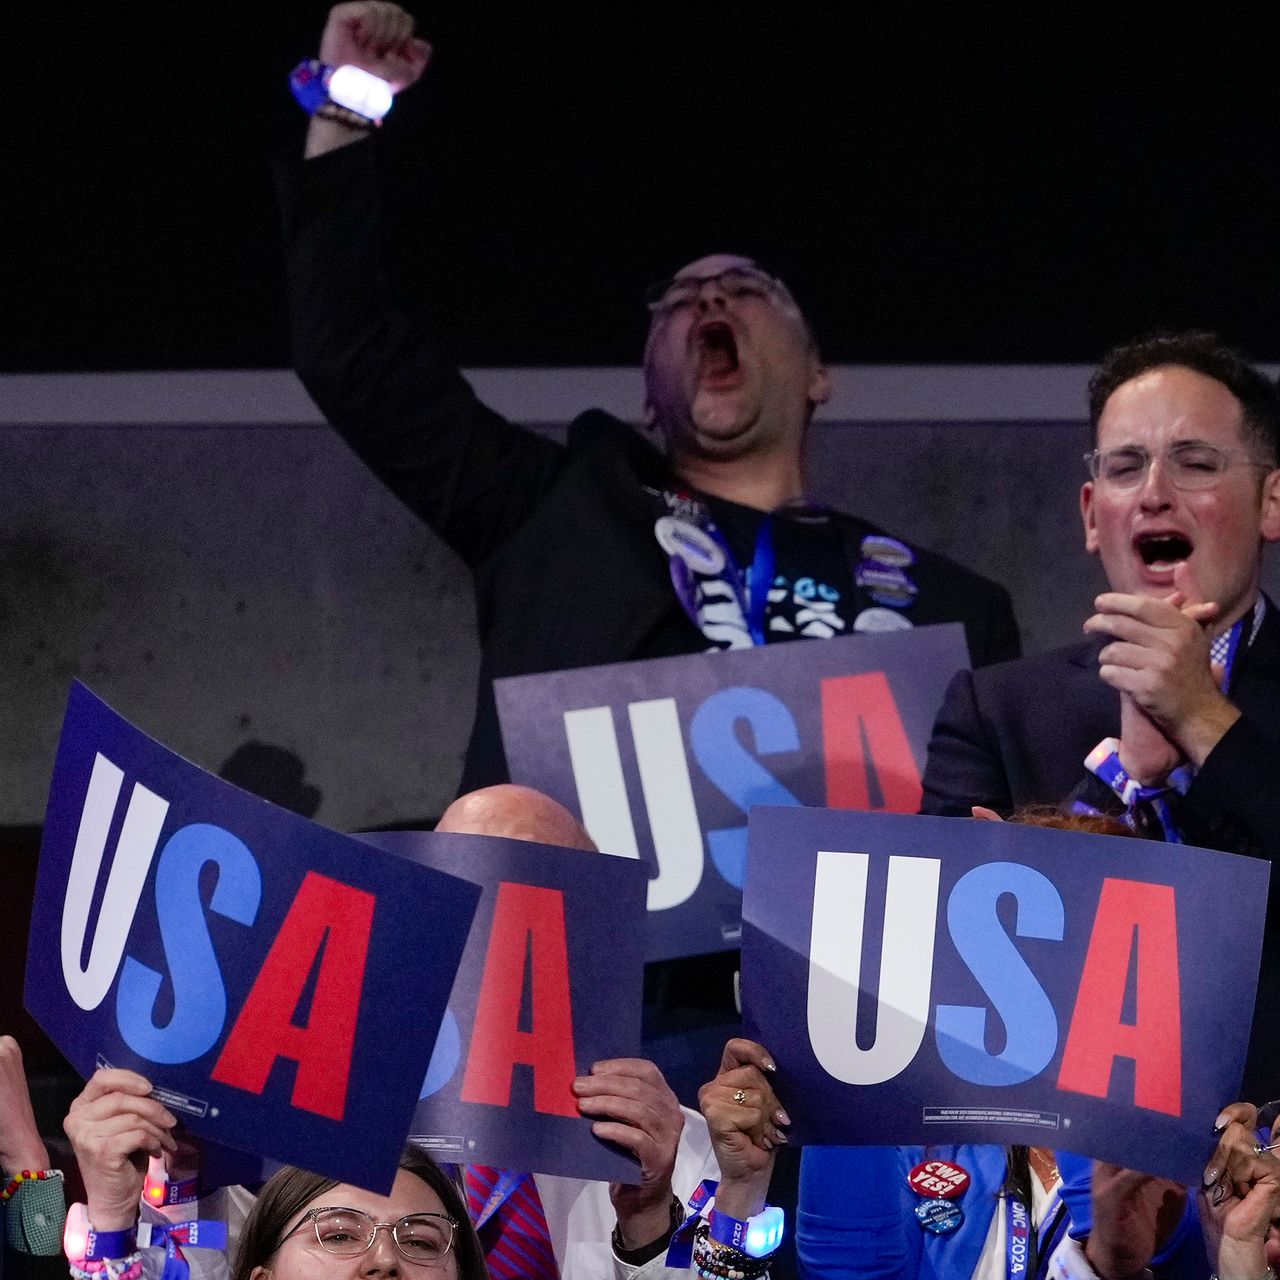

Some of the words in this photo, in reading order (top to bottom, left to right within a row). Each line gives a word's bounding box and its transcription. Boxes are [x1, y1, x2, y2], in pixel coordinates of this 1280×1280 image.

[563, 671, 922, 911] USA
[60, 752, 376, 1122] USA
[806, 851, 1183, 1118] USA
[912, 1172, 955, 1195] YES!
[926, 1162, 968, 1186] CWA
[1012, 1201, 1026, 1228] DNC
[733, 1223, 742, 1247] DNC
[1011, 1237, 1025, 1274] 2024
